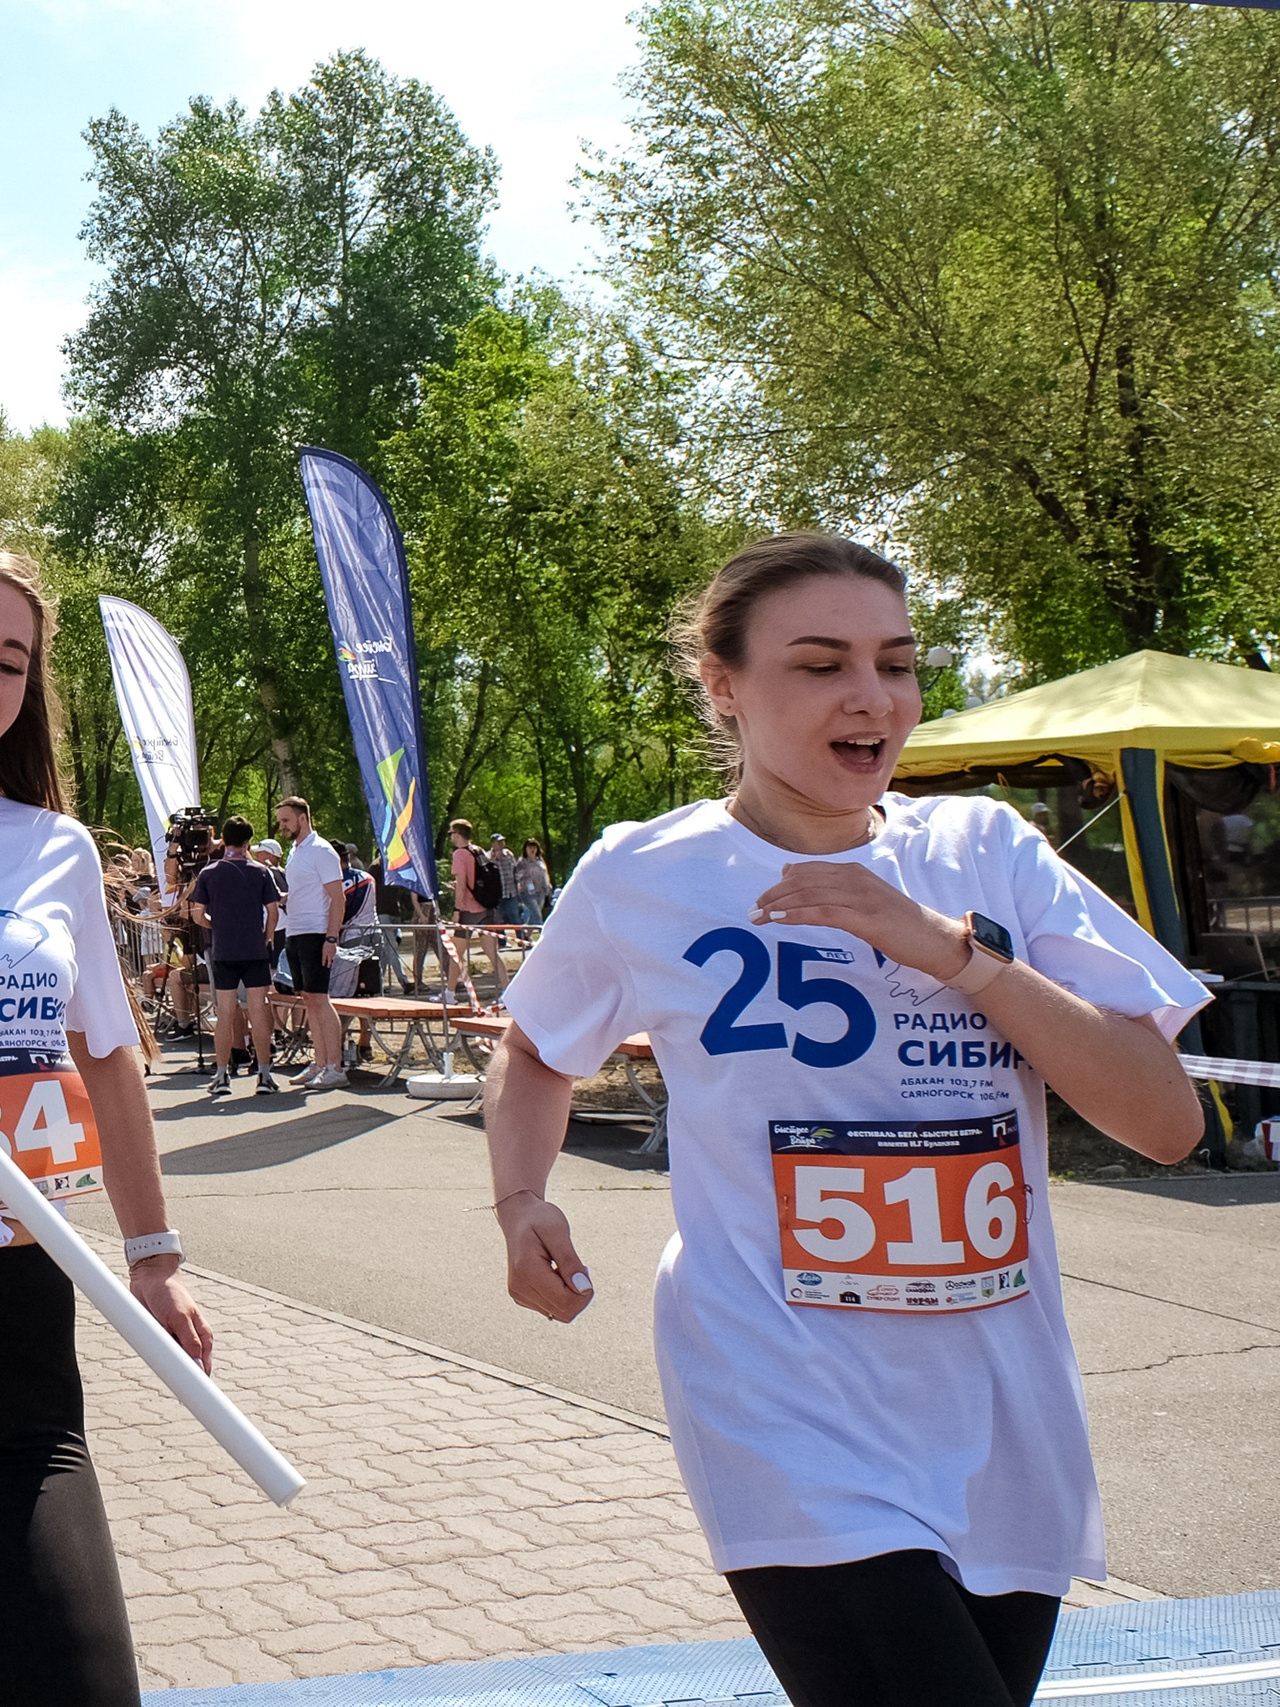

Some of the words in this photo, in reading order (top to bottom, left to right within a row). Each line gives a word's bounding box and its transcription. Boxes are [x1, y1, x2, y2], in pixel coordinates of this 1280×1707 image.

[682, 927, 876, 1068] 25
[894, 1012, 987, 1033] РАДИО
[900, 1077, 944, 1086] АБАКАН
[950, 1078, 977, 1089] 103,7
[980, 1080, 993, 1088] FM
[901, 1089, 974, 1100] САЯНОГОРСК
[996, 1090, 1009, 1099] FM
[792, 1162, 1017, 1265] 516
